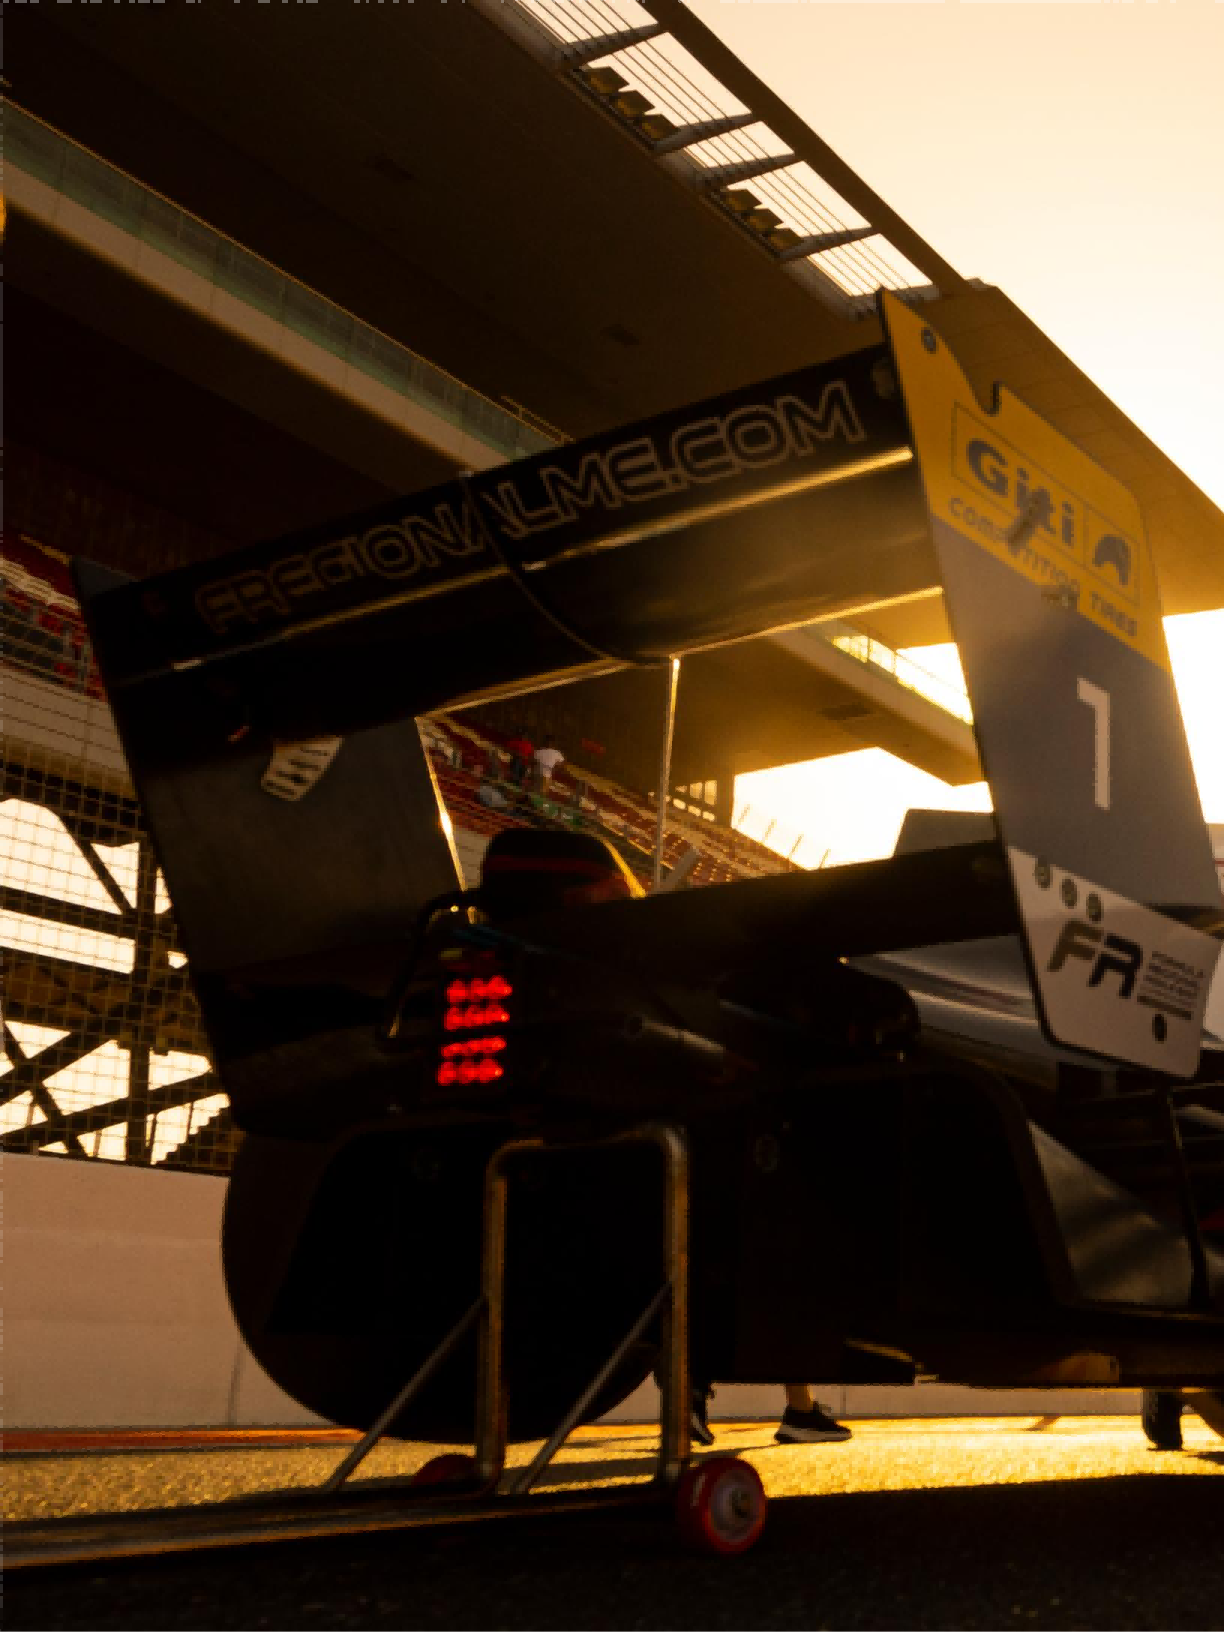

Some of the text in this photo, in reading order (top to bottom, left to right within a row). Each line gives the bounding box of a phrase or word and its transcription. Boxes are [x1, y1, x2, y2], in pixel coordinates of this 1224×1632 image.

[966, 438, 1074, 548] Giti
[1076, 675, 1111, 811] 1
[1046, 919, 1143, 999] FR
